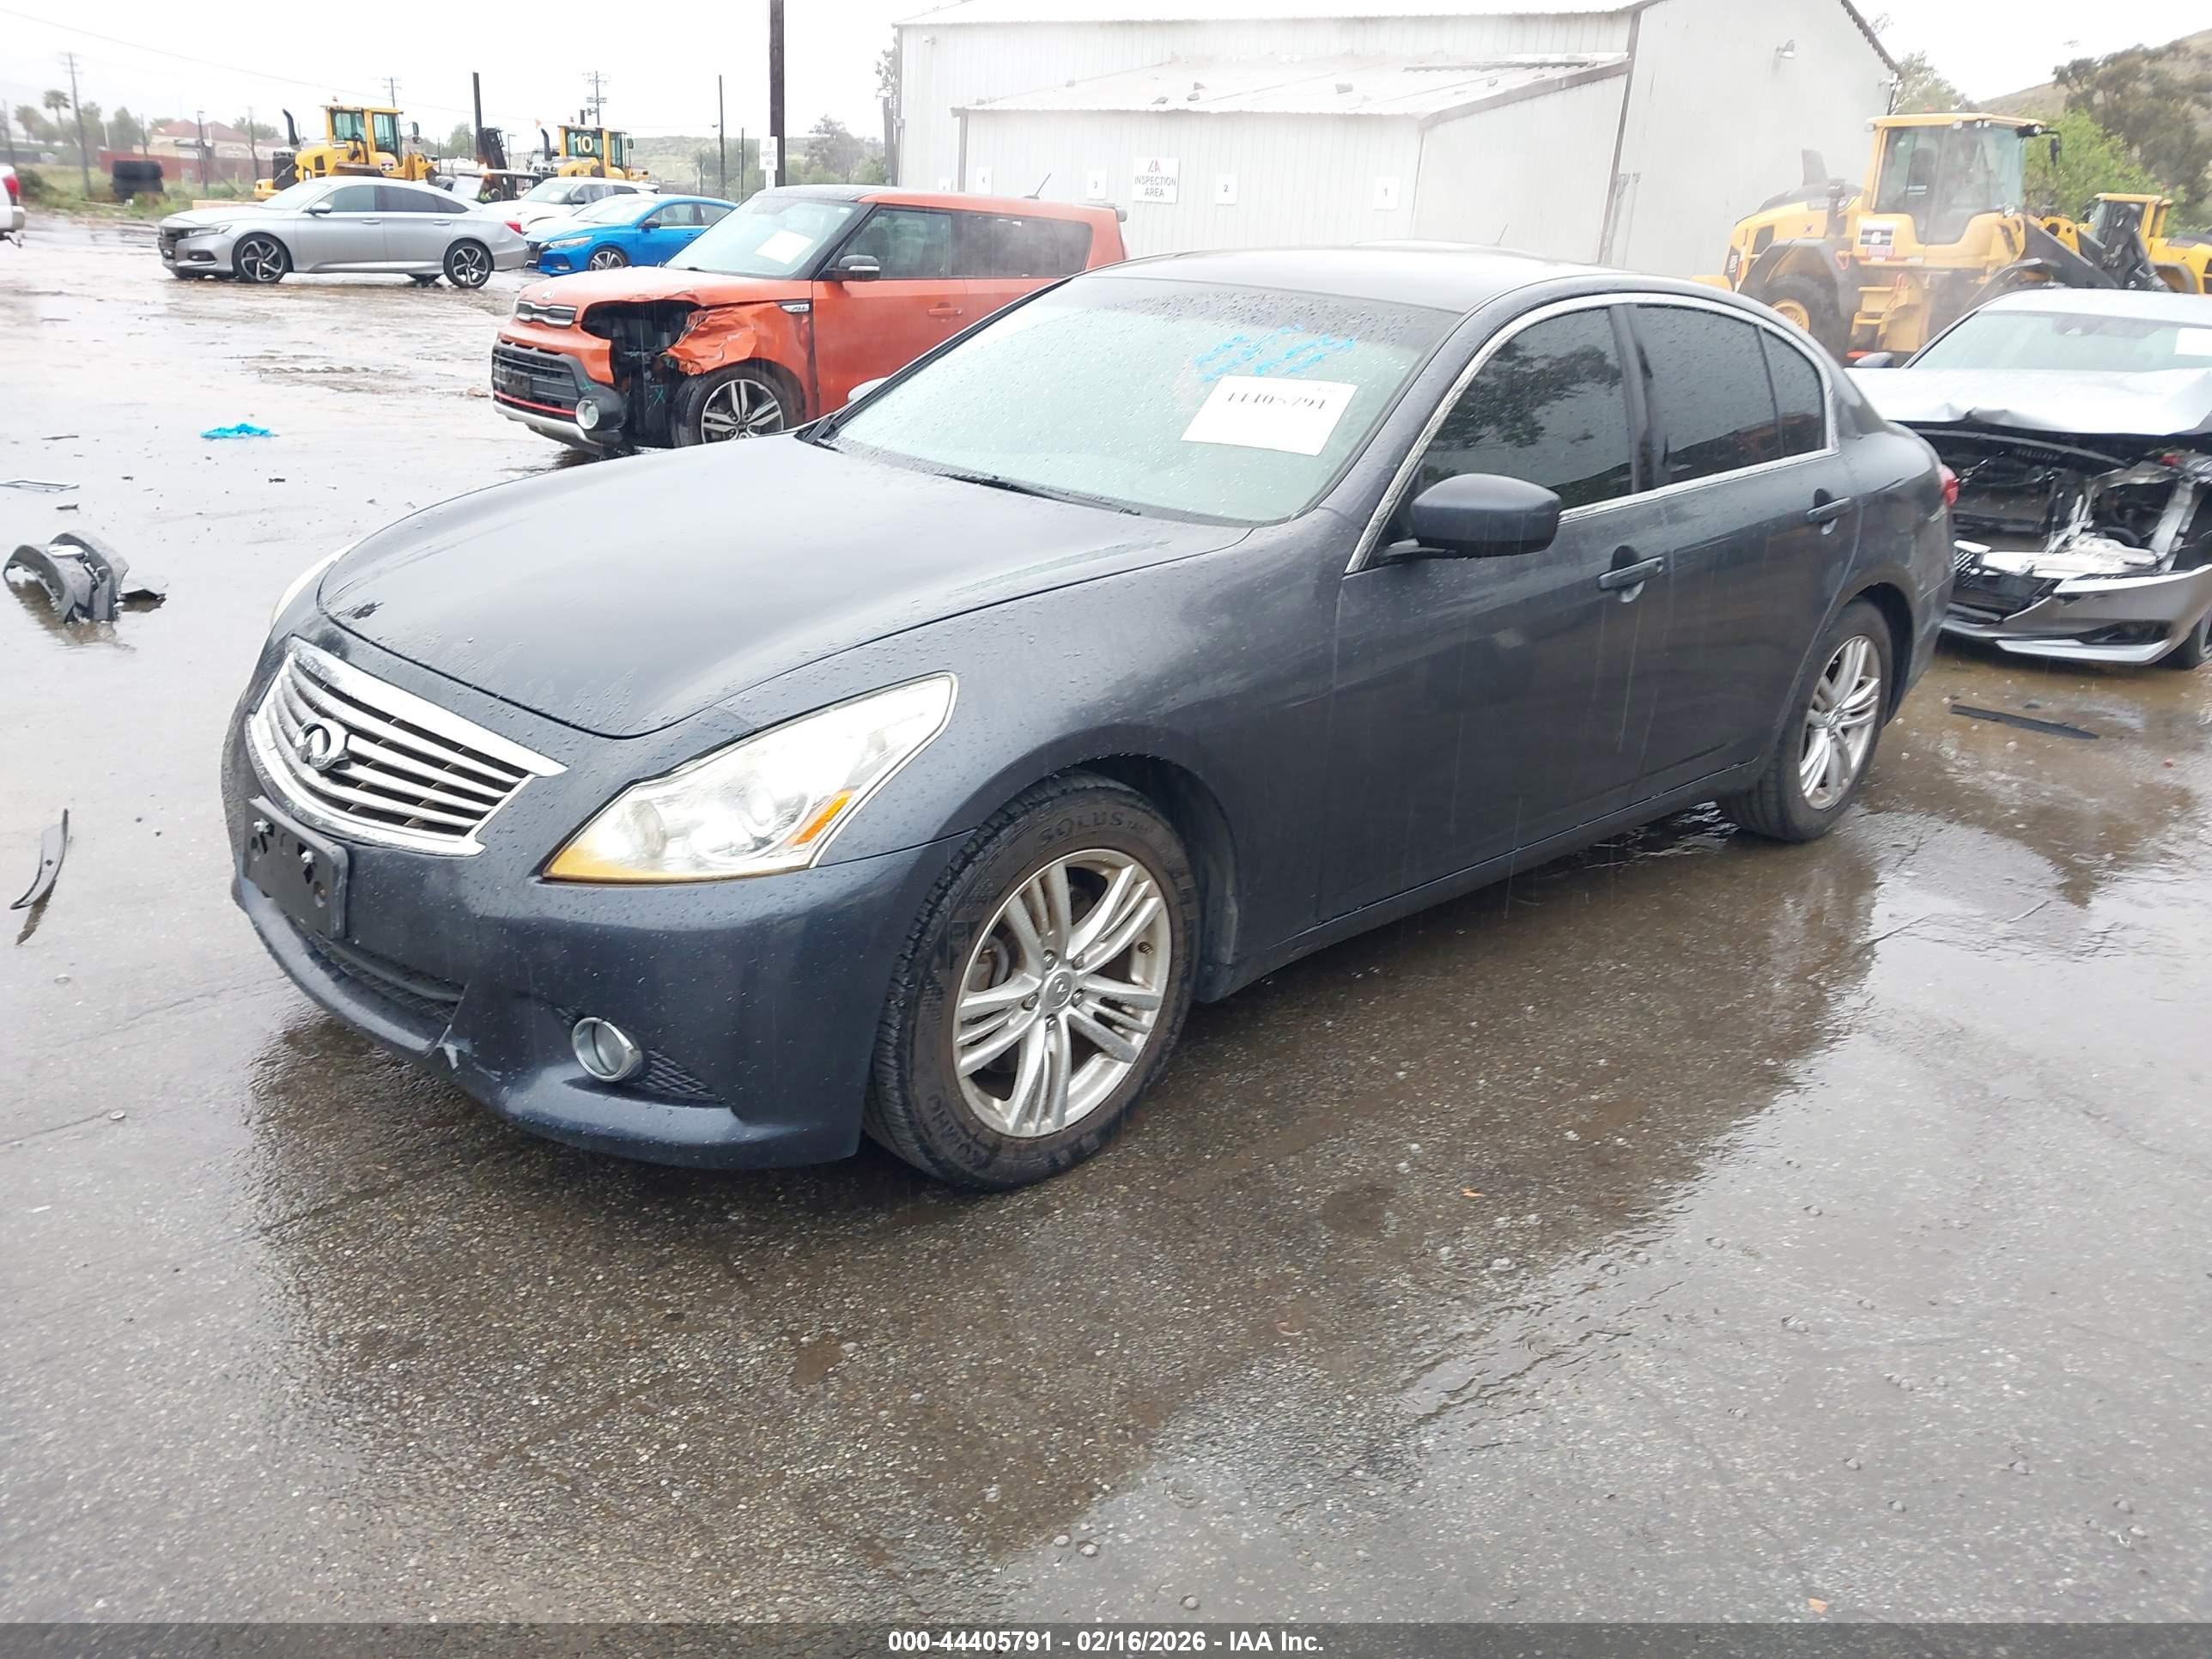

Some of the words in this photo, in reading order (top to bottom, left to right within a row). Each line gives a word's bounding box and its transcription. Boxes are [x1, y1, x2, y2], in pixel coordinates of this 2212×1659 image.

[574, 136, 593, 153] 10
[1134, 174, 1176, 186] INSPECTION
[1145, 187, 1164, 198] AREA
[1224, 184, 1229, 193] 2
[1037, 811, 1126, 848] SOLUS
